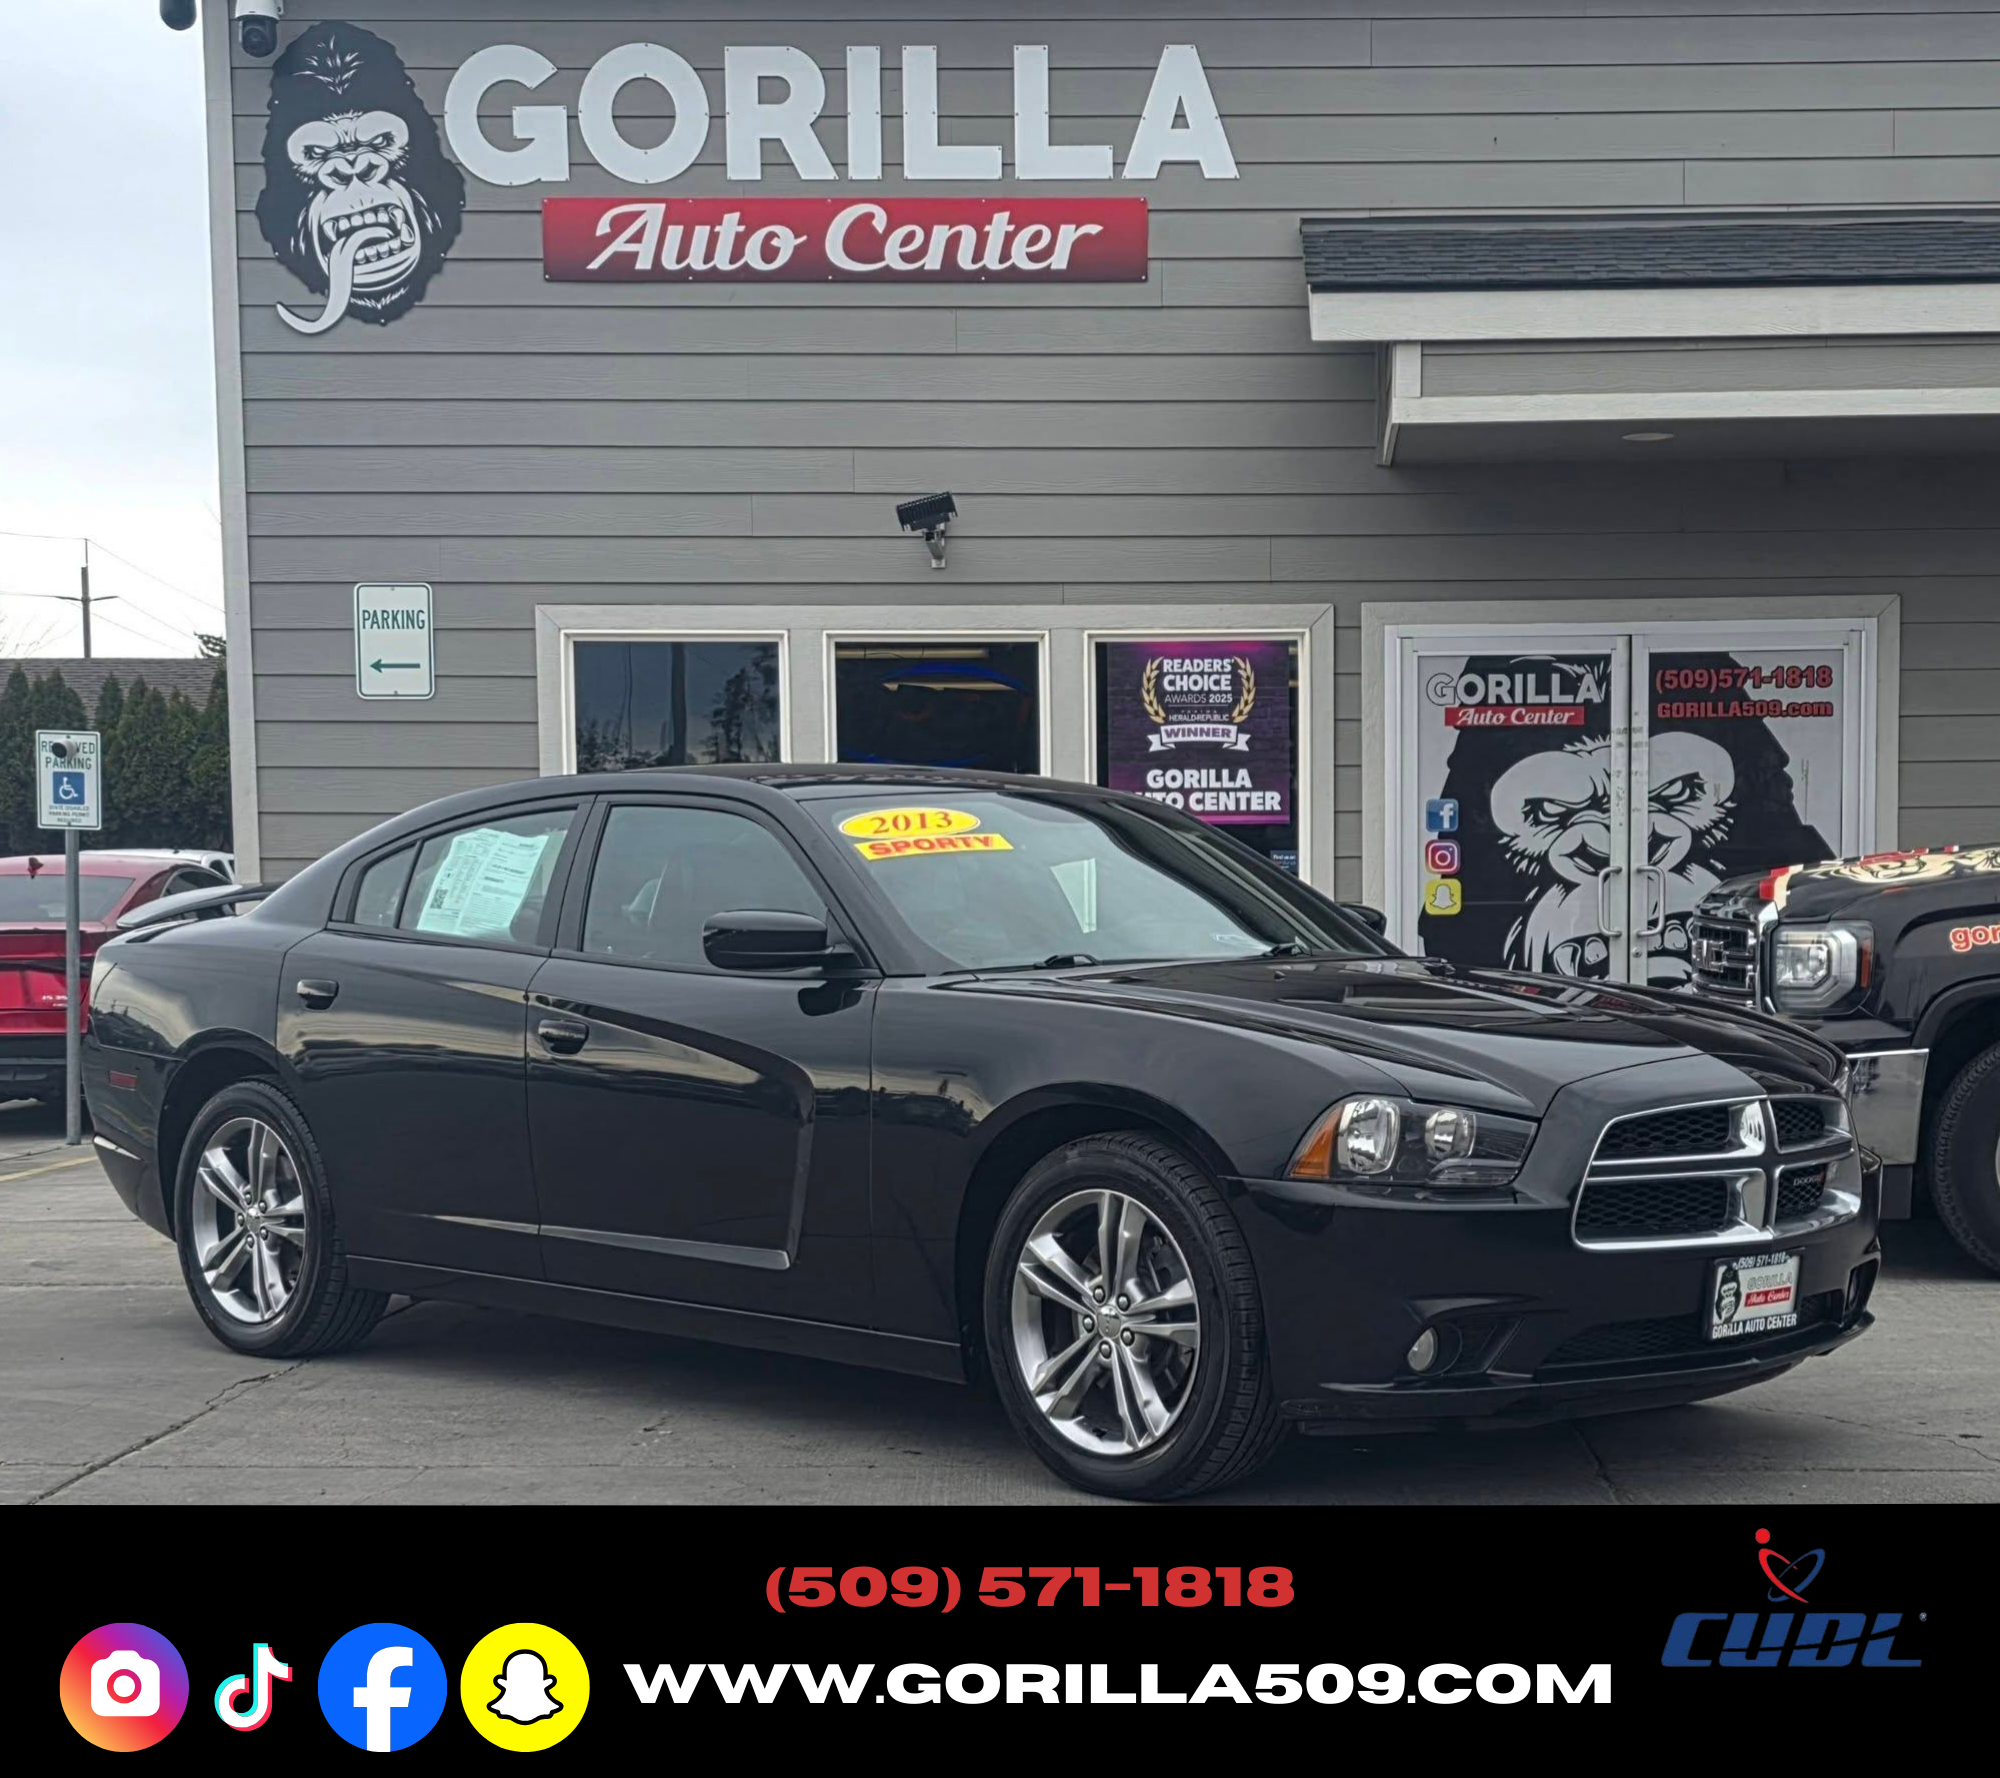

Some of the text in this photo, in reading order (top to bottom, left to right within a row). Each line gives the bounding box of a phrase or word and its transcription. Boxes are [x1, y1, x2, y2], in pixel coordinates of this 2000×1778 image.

[443, 42, 1240, 185] GORILLA
[586, 203, 1104, 271] Auto Center
[362, 609, 425, 630] PARKING
[1163, 658, 1235, 673] READERS'
[1163, 674, 1232, 691] CHOICE
[1426, 672, 1603, 706] GORILLA
[1655, 665, 1833, 693] (509)571-1818
[1164, 693, 1233, 703] AWARDS 2025
[1456, 707, 1575, 725] Auto Center
[1657, 700, 1834, 718] GORILLA509.com
[1164, 727, 1232, 739] WINNER
[45, 757, 92, 770] PARKING
[1146, 768, 1252, 789] GORILLA
[1189, 791, 1282, 811] CENTER
[870, 811, 953, 834] 2013
[868, 836, 992, 856] SPORTY
[1747, 1272, 1793, 1290] GORILLA
[1745, 1317, 1765, 1333] AUTO
[1767, 1313, 1797, 1330] CENTER
